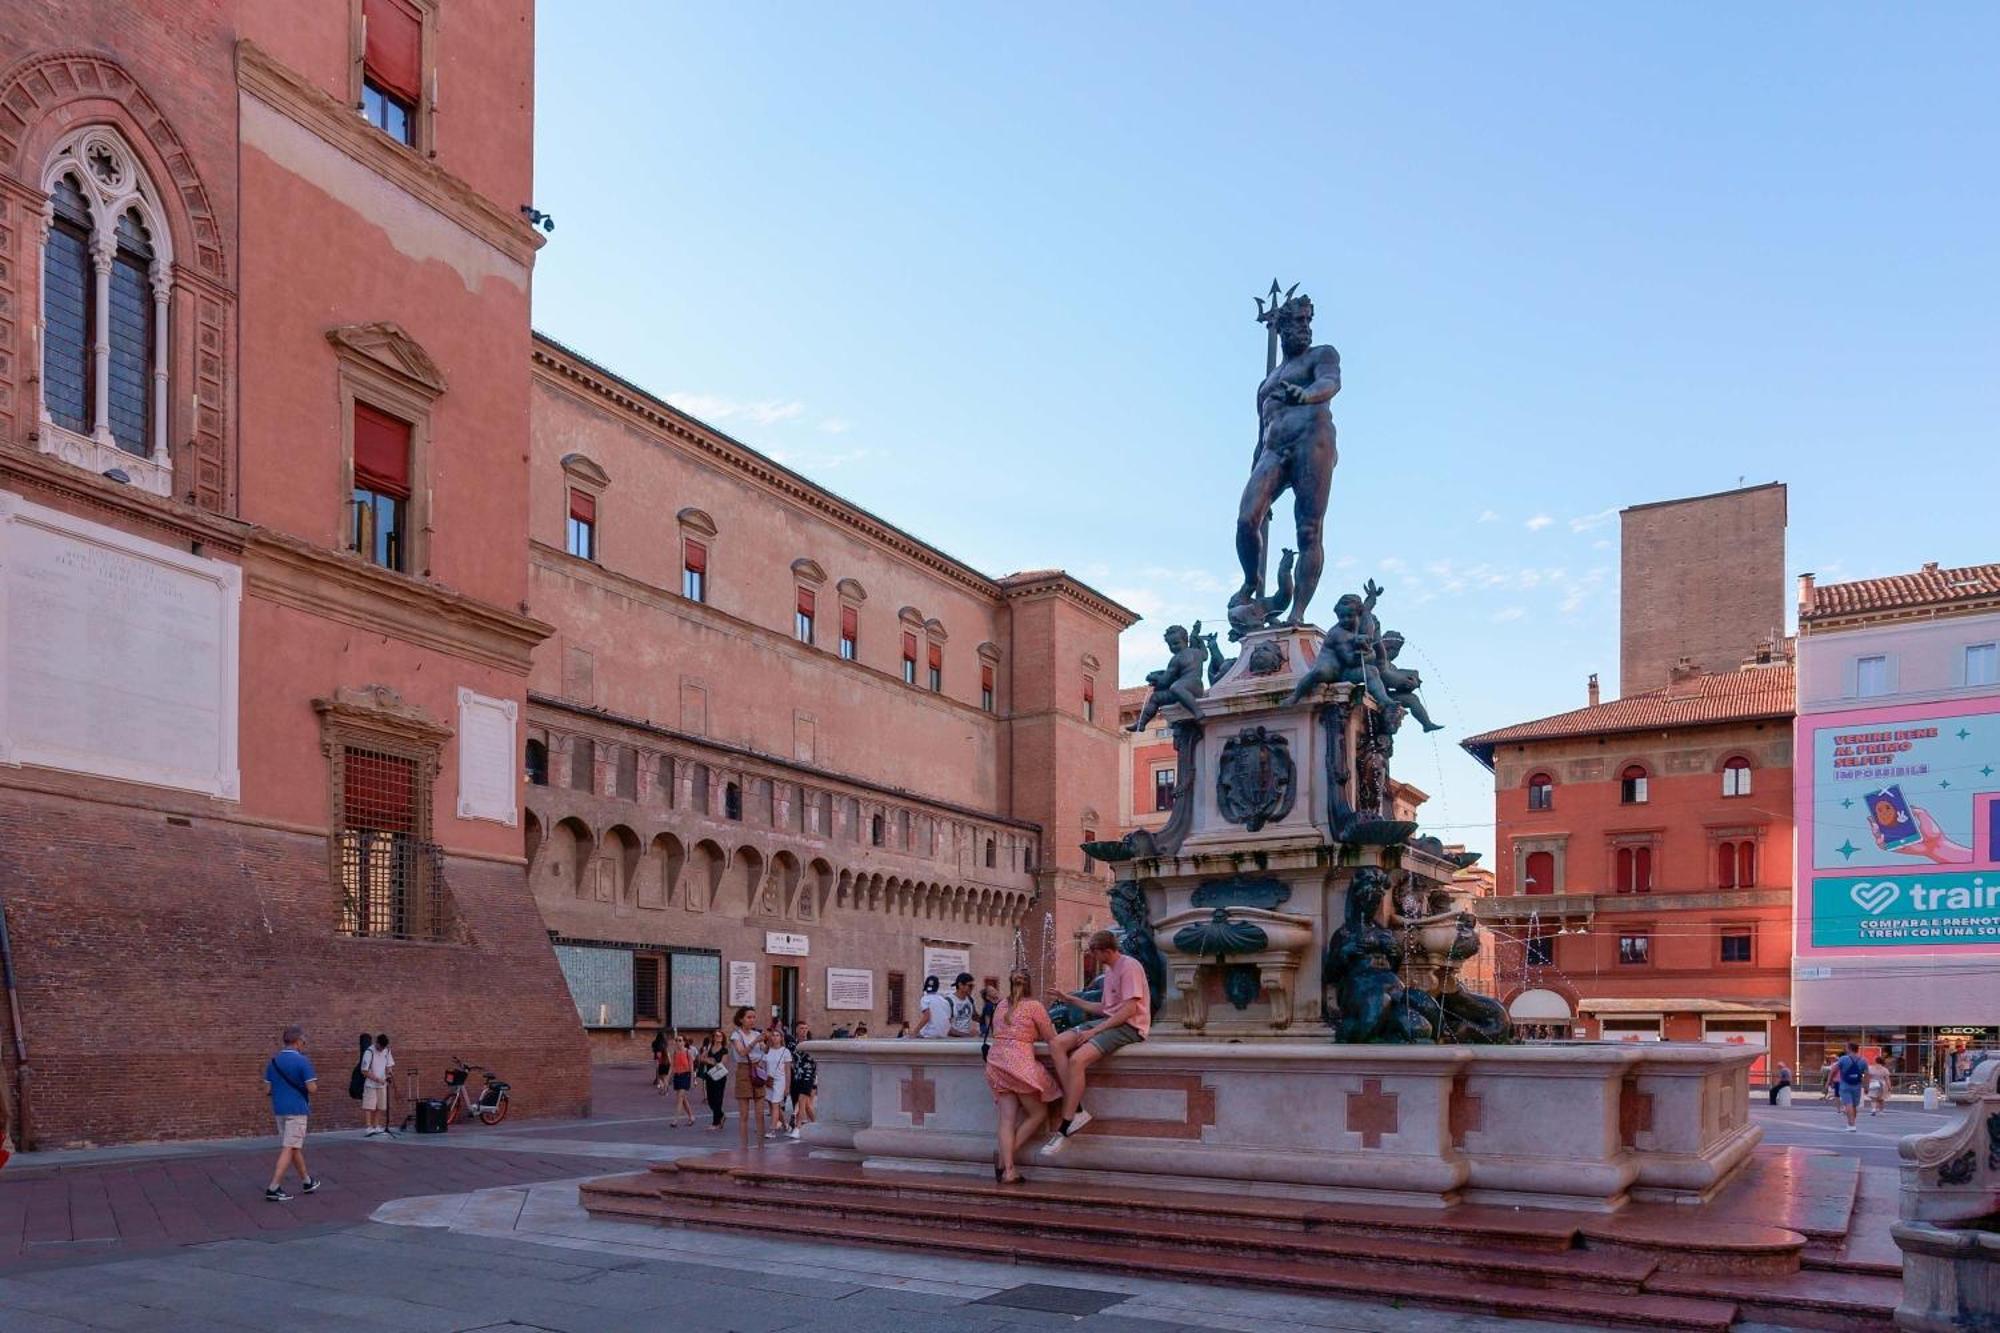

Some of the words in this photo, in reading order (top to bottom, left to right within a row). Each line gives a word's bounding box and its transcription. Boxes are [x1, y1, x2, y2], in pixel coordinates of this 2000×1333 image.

[1834, 731, 1892, 745] VENIRE
[1894, 728, 1938, 740] BENE
[1834, 746, 1854, 756] AL
[1856, 741, 1912, 754] PRIMO
[1860, 919, 1928, 928] COMPARA
[1931, 918, 1939, 926] E
[1868, 929, 1907, 938] TRENI
[1911, 927, 1940, 937] CON
[1944, 926, 1974, 936] UNA
[1977, 926, 2000, 936] SO
[1940, 1026, 1987, 1035] GEOX
